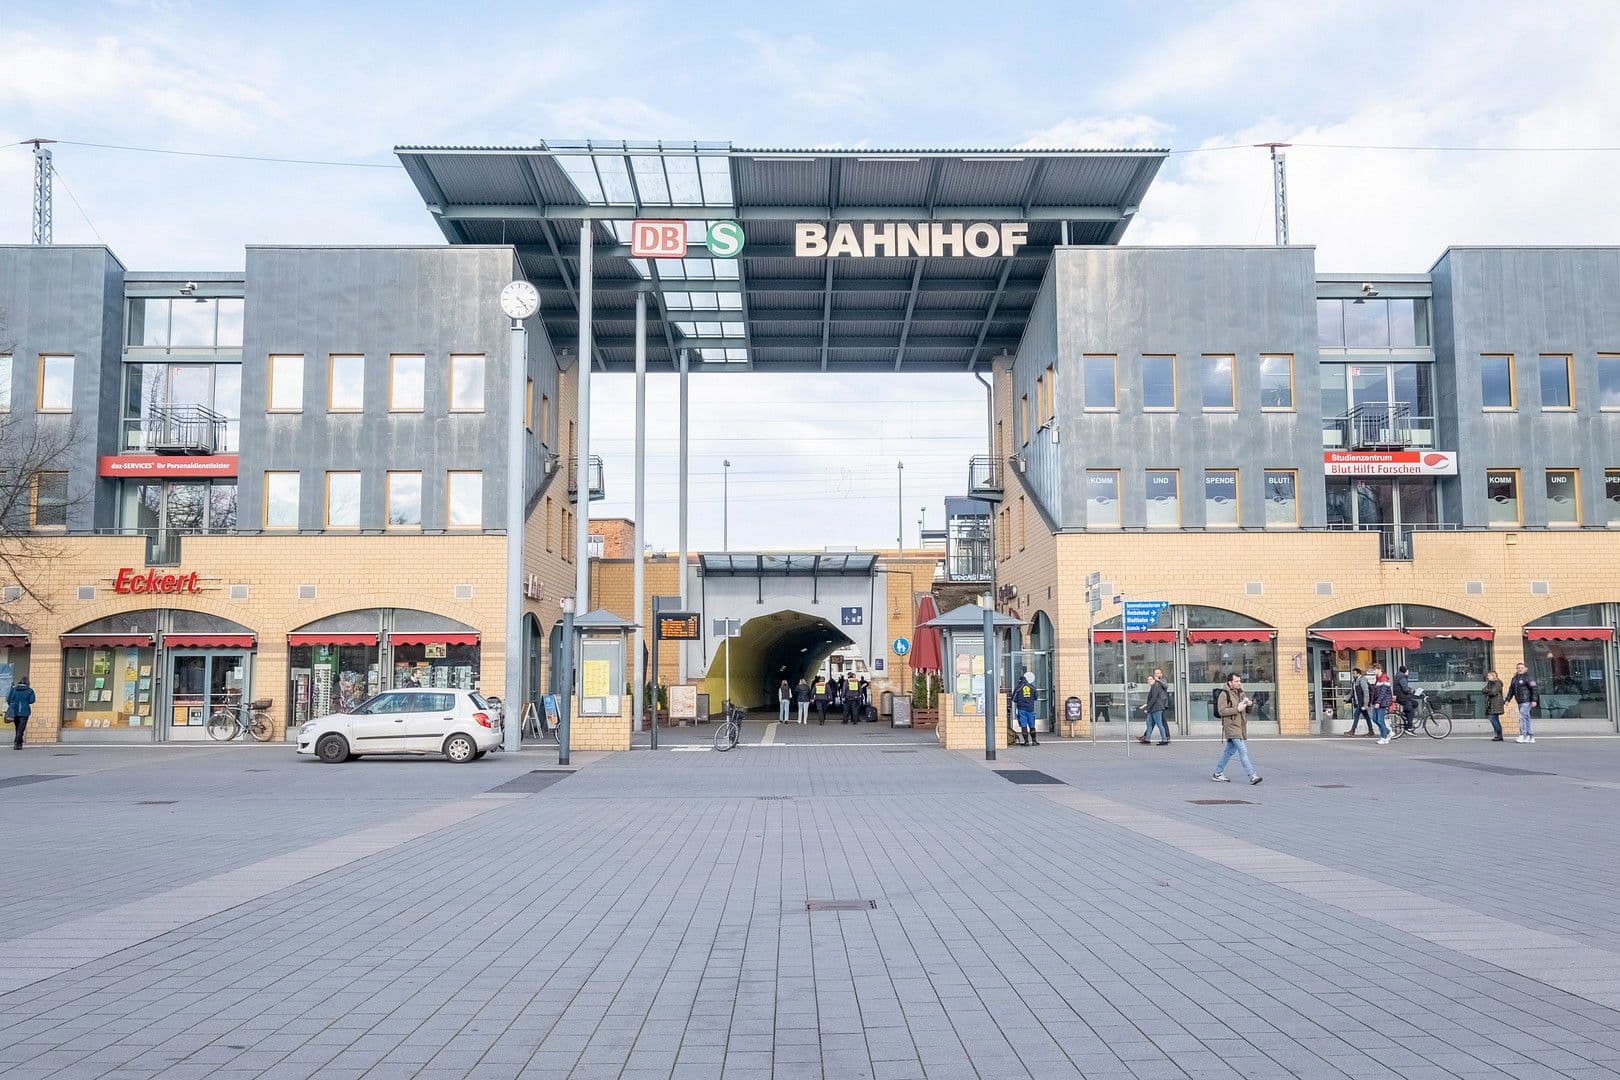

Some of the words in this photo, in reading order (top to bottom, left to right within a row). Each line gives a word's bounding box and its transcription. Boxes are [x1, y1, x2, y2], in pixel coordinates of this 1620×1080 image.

[640, 226, 680, 251] DB
[711, 223, 738, 255] S
[795, 222, 1029, 258] BAHNHOF
[156, 462, 165, 470] Ihr
[167, 462, 230, 470] Personaldienstleister
[1331, 453, 1393, 462] Studienzentrum
[1331, 464, 1350, 474] Blut
[1353, 464, 1375, 474] Hilft
[1377, 464, 1420, 474] Forschen
